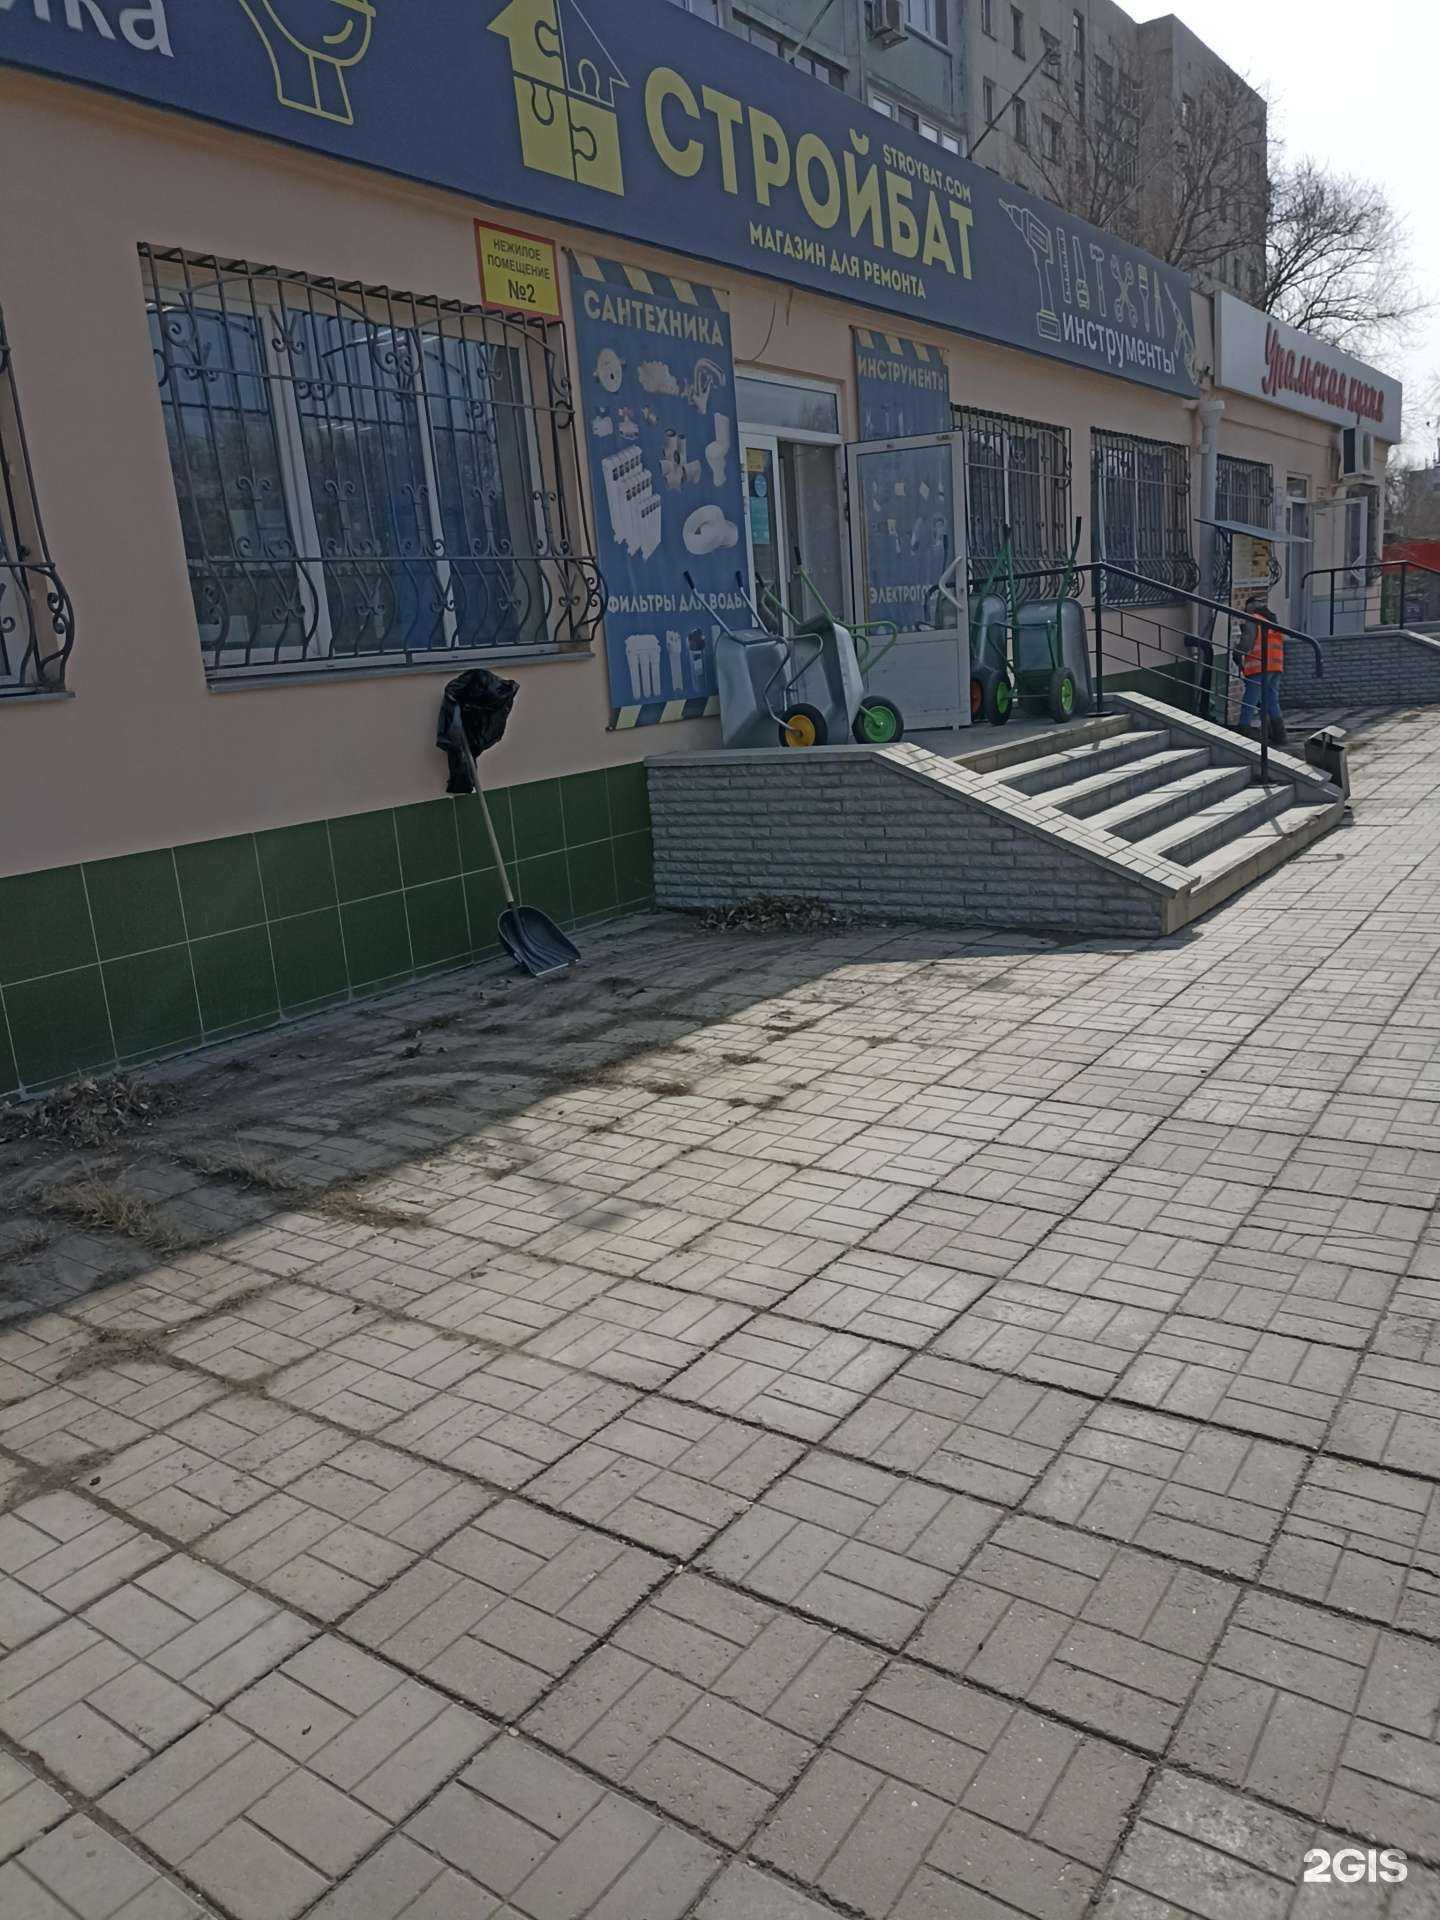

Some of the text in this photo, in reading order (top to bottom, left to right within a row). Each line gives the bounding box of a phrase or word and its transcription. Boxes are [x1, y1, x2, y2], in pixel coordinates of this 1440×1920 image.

[644, 66, 974, 280] СТРОЙБАТ
[883, 144, 971, 203] STROYBAT.COM
[487, 254, 550, 280] ПОМЕЩЕНИЕ
[494, 239, 541, 260] НЕЖИЛОЕ
[750, 221, 926, 299] МАГАЗИН ДЛЯ РЕМОНТА
[508, 279, 536, 303] №2
[583, 290, 724, 347] САНТЕХНИКА
[857, 355, 947, 392] ИНСТРУМЕНТЫ
[607, 594, 676, 613] ФИЛЬТРЫ
